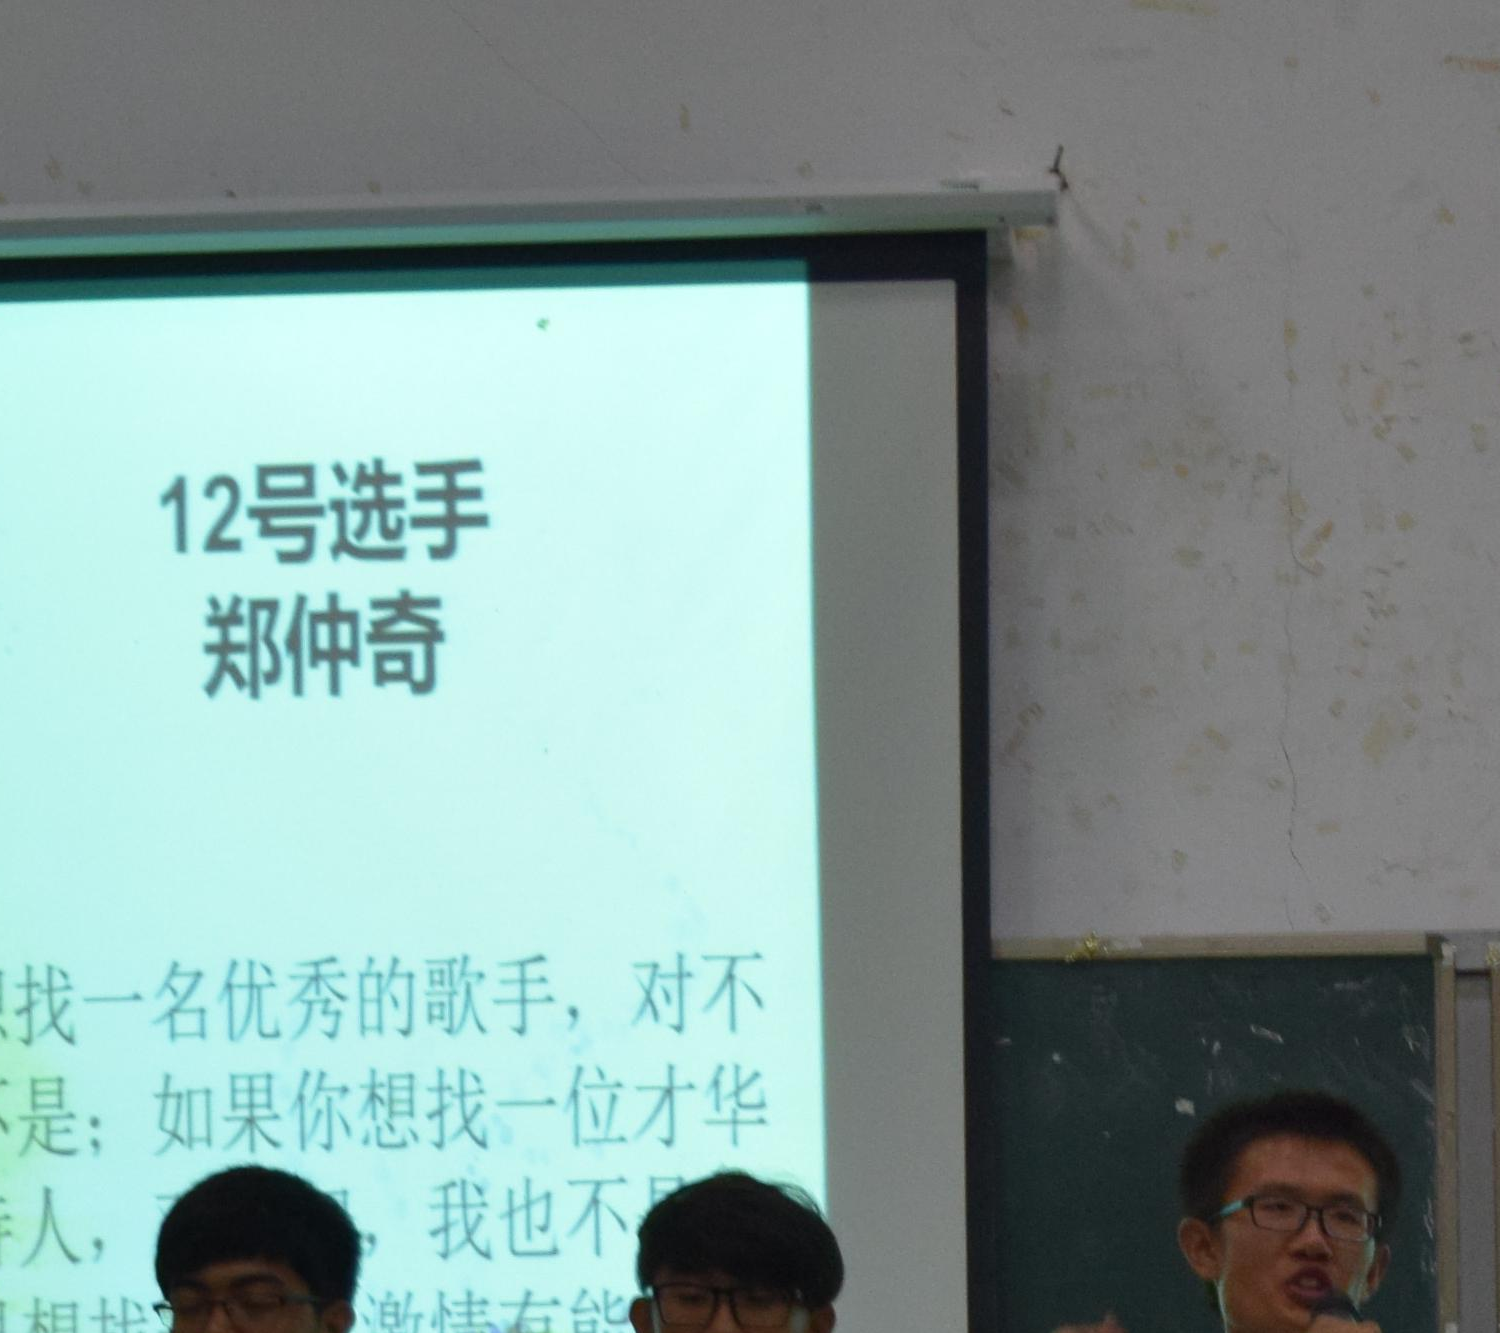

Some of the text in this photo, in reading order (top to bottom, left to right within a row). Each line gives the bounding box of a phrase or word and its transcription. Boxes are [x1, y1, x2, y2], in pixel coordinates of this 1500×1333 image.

[159, 456, 491, 565] 12号选手
[201, 588, 446, 700] 郑仲奇
